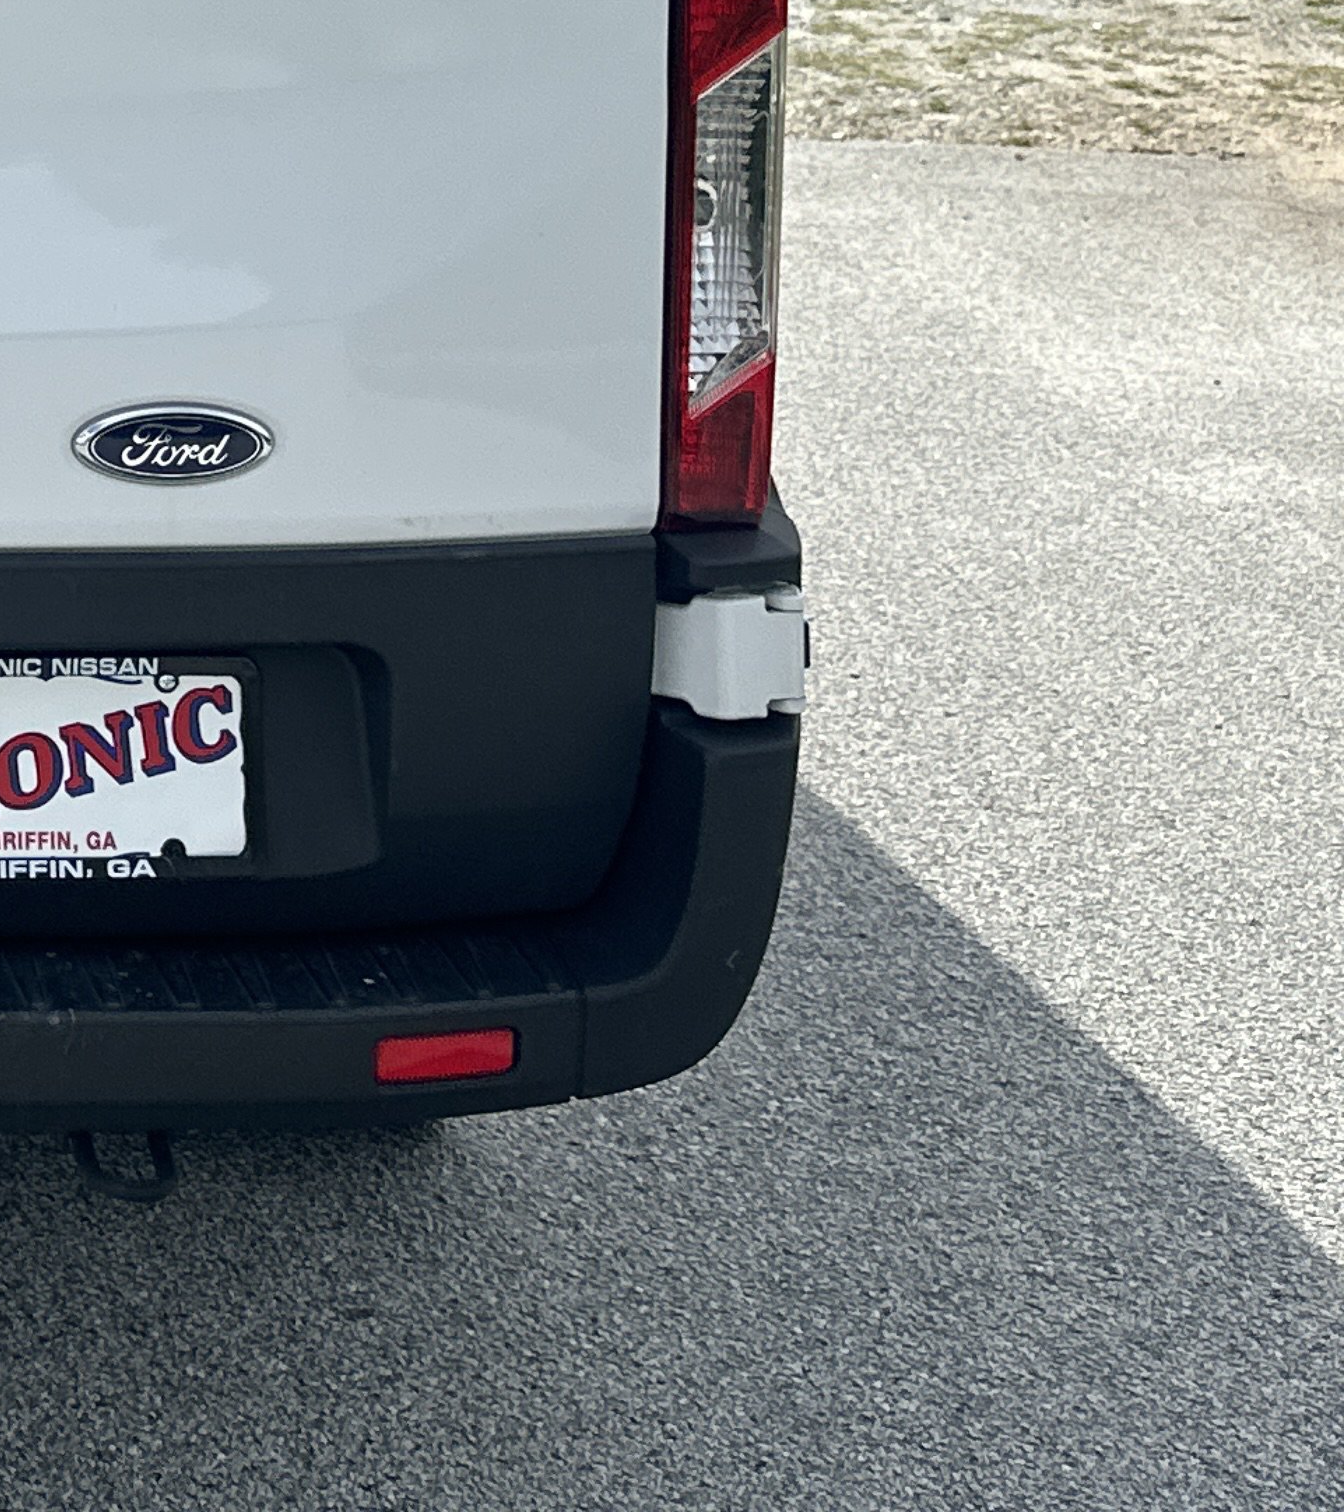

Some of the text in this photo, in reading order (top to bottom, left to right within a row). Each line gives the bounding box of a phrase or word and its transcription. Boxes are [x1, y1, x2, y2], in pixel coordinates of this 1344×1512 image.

[120, 423, 230, 467] Ford
[51, 657, 159, 676] NISSAN
[86, 831, 117, 850] GA
[107, 859, 157, 878] GA
